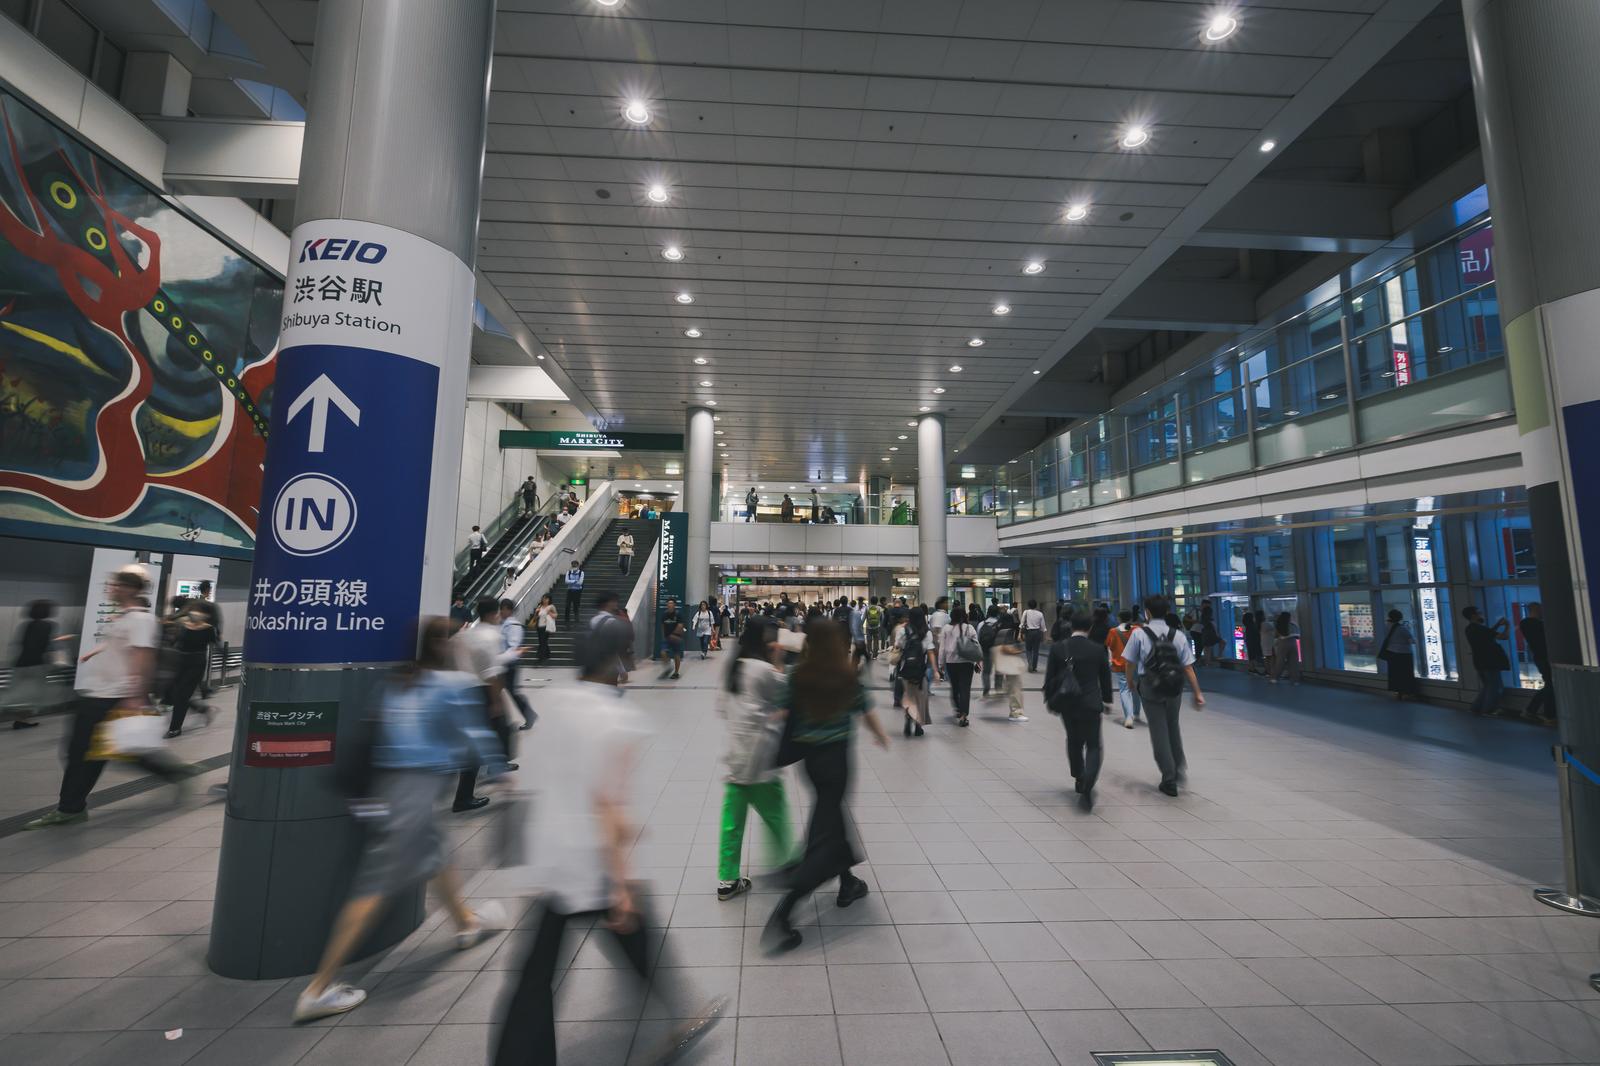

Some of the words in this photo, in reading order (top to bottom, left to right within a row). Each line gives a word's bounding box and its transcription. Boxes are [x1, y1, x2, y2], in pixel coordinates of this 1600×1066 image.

[299, 238, 388, 264] KEIO
[293, 275, 383, 306] 渋谷駅
[282, 313, 331, 332] Shibuya
[335, 311, 401, 335] Station
[559, 437, 593, 445] MARK
[595, 437, 624, 446] CITY
[285, 497, 336, 531] IN
[663, 519, 671, 551] MARK
[1415, 540, 1429, 549] 3F
[662, 553, 670, 580] CITY
[253, 577, 368, 607] 井の頭線
[335, 611, 385, 631] Line
